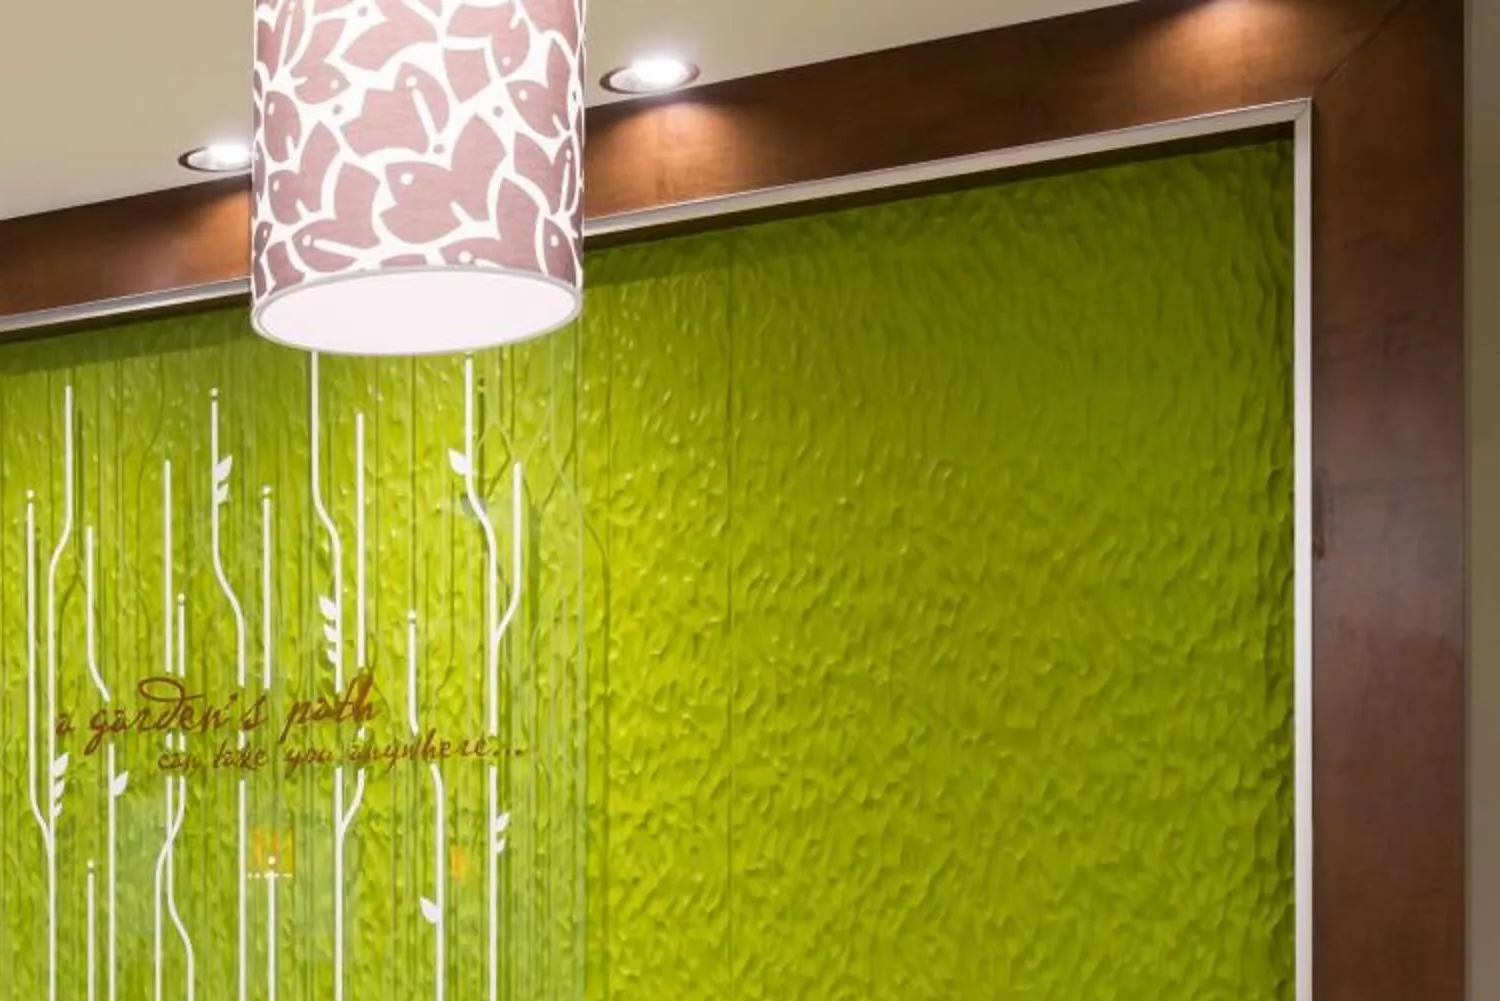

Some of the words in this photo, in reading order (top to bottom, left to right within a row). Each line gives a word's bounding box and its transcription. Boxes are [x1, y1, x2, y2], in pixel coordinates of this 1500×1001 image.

[55, 711, 76, 736] a
[82, 676, 269, 757] garden's
[277, 668, 381, 745] path
[156, 751, 202, 771] can
[212, 738, 268, 771] take
[284, 748, 333, 780] you
